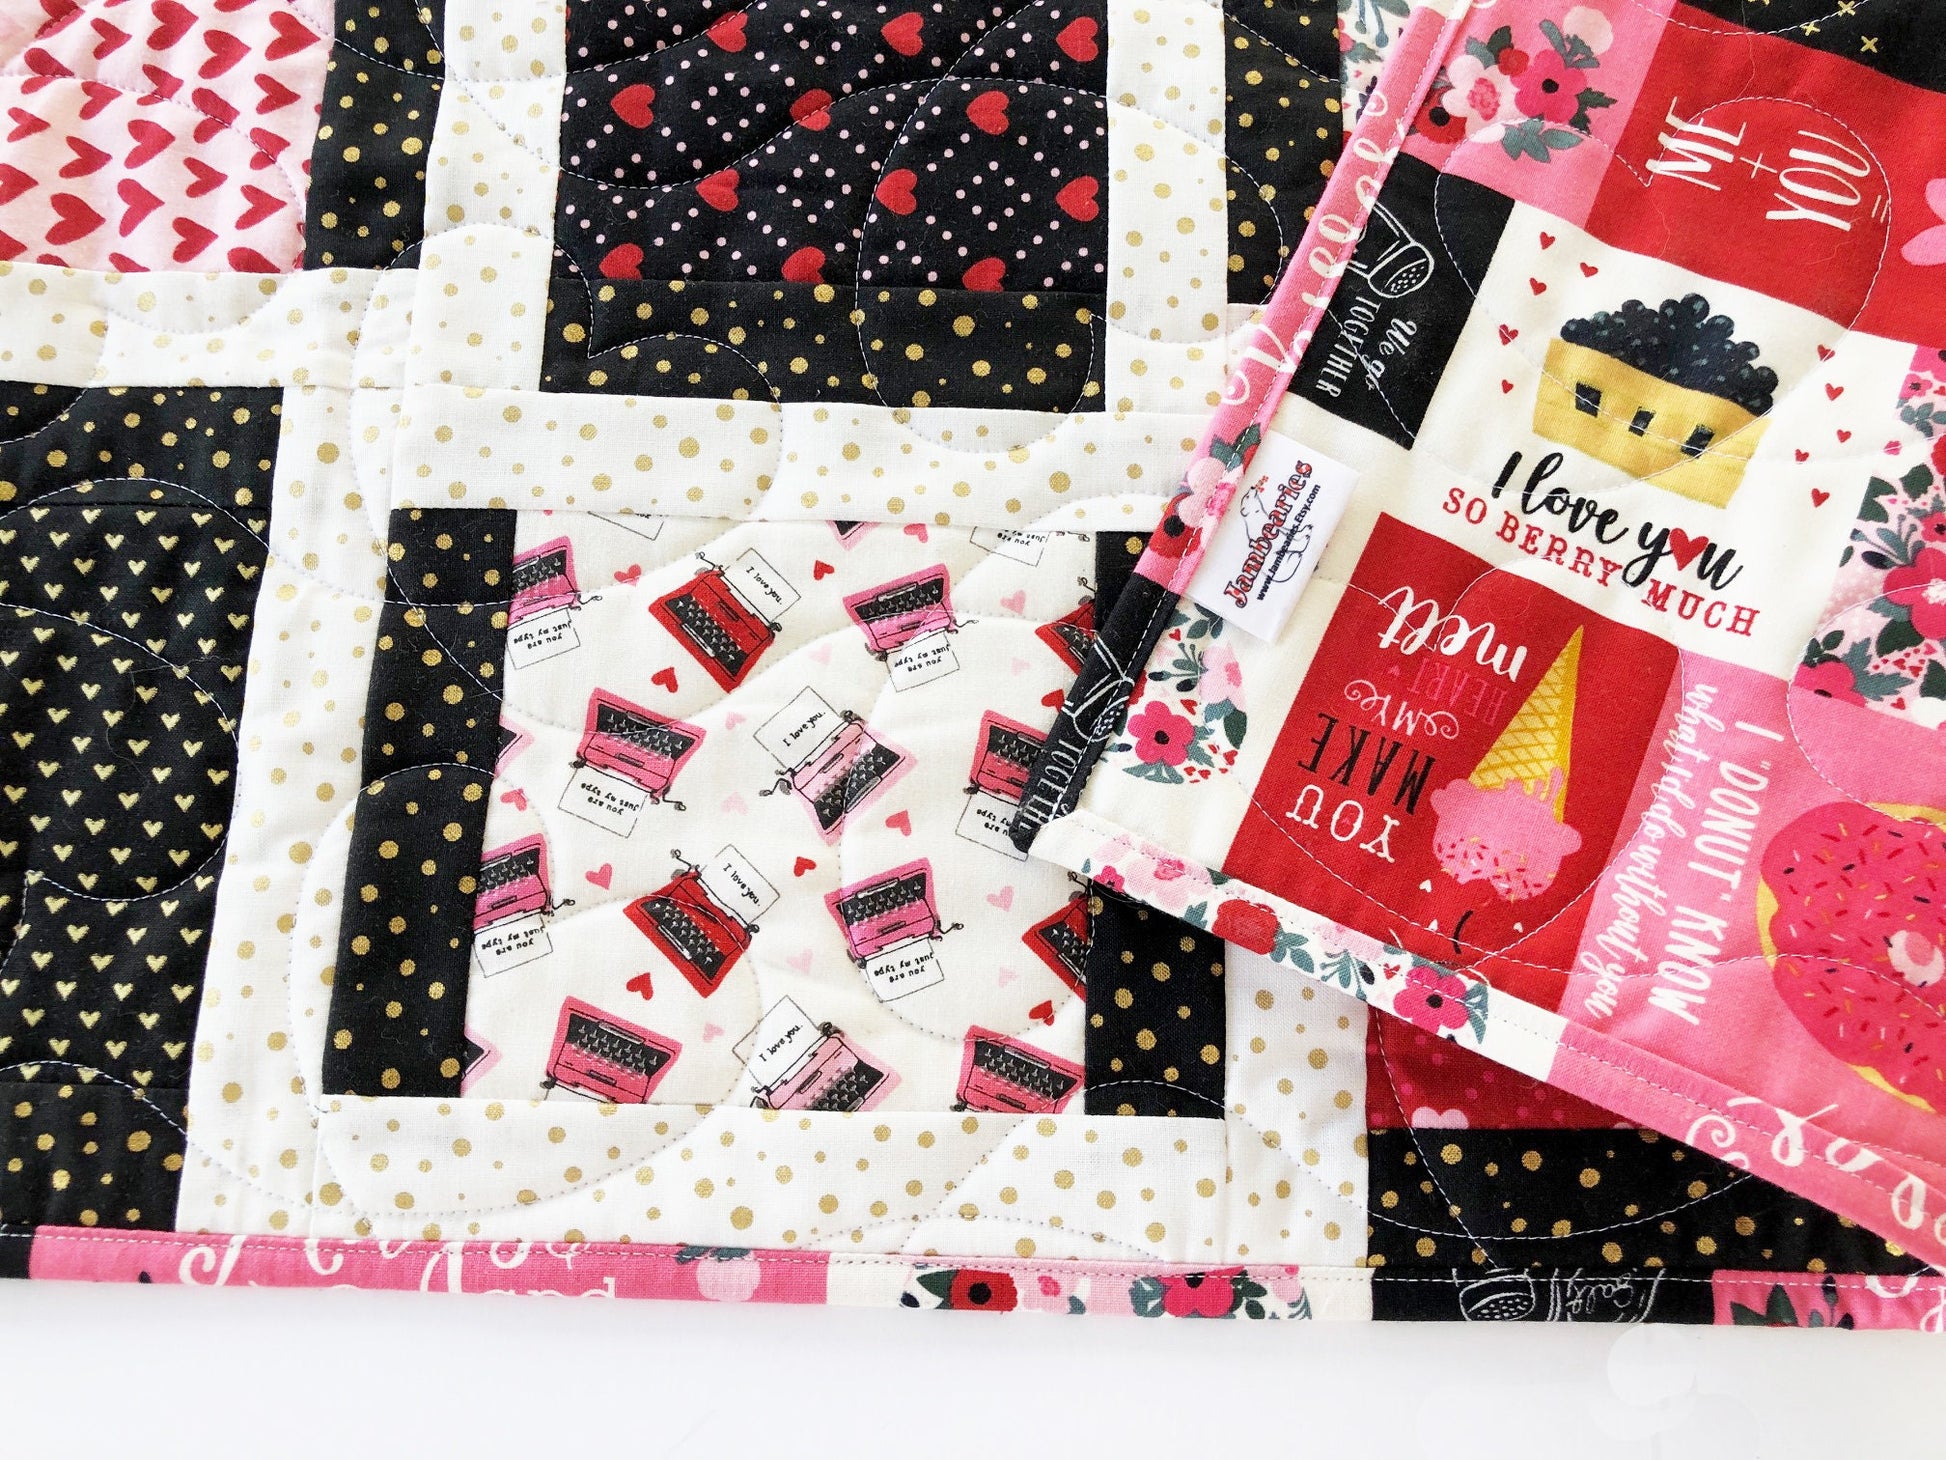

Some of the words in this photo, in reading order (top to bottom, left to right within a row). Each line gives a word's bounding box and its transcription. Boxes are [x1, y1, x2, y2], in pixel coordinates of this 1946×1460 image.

[1645, 96, 1747, 191] ME
[1765, 130, 1871, 232] YOU
[1315, 296, 1381, 397] TOGETHER
[1379, 318, 1417, 355] We
[1361, 354, 1386, 391] go
[1490, 451, 1523, 499] I
[1521, 452, 1630, 544] love
[1223, 460, 1313, 608] Jambearies
[1257, 484, 1322, 601] www.Jambearies.Etsy.com
[1442, 487, 1488, 524] SO
[1495, 511, 1623, 587] BERRY
[1641, 578, 1761, 637] MUCH
[746, 566, 755, 574] I
[753, 573, 770, 589] love
[764, 588, 783, 605] you.
[545, 632, 563, 644] you
[925, 656, 942, 666] you
[1378, 585, 1528, 682] melt
[1344, 679, 1459, 740] MY
[1407, 658, 1508, 728] HEART
[1663, 684, 1726, 764] what
[783, 738, 792, 747] I
[789, 723, 809, 739] love
[806, 711, 826, 728] you.
[1297, 711, 1437, 815] MAKE
[1735, 720, 1786, 742] I
[606, 804, 625, 815] you
[1285, 784, 1400, 863] YOU
[1640, 801, 1687, 843] do
[723, 862, 732, 871] I
[730, 870, 747, 890] love
[741, 887, 761, 907] you.
[1595, 844, 1668, 963] without
[516, 938, 534, 949] you
[908, 965, 926, 976] you
[1648, 905, 1730, 1026] KNOW
[1580, 950, 1626, 1019] you
[758, 1053, 767, 1062] I
[766, 1037, 786, 1055] love
[784, 1025, 804, 1044] you.
